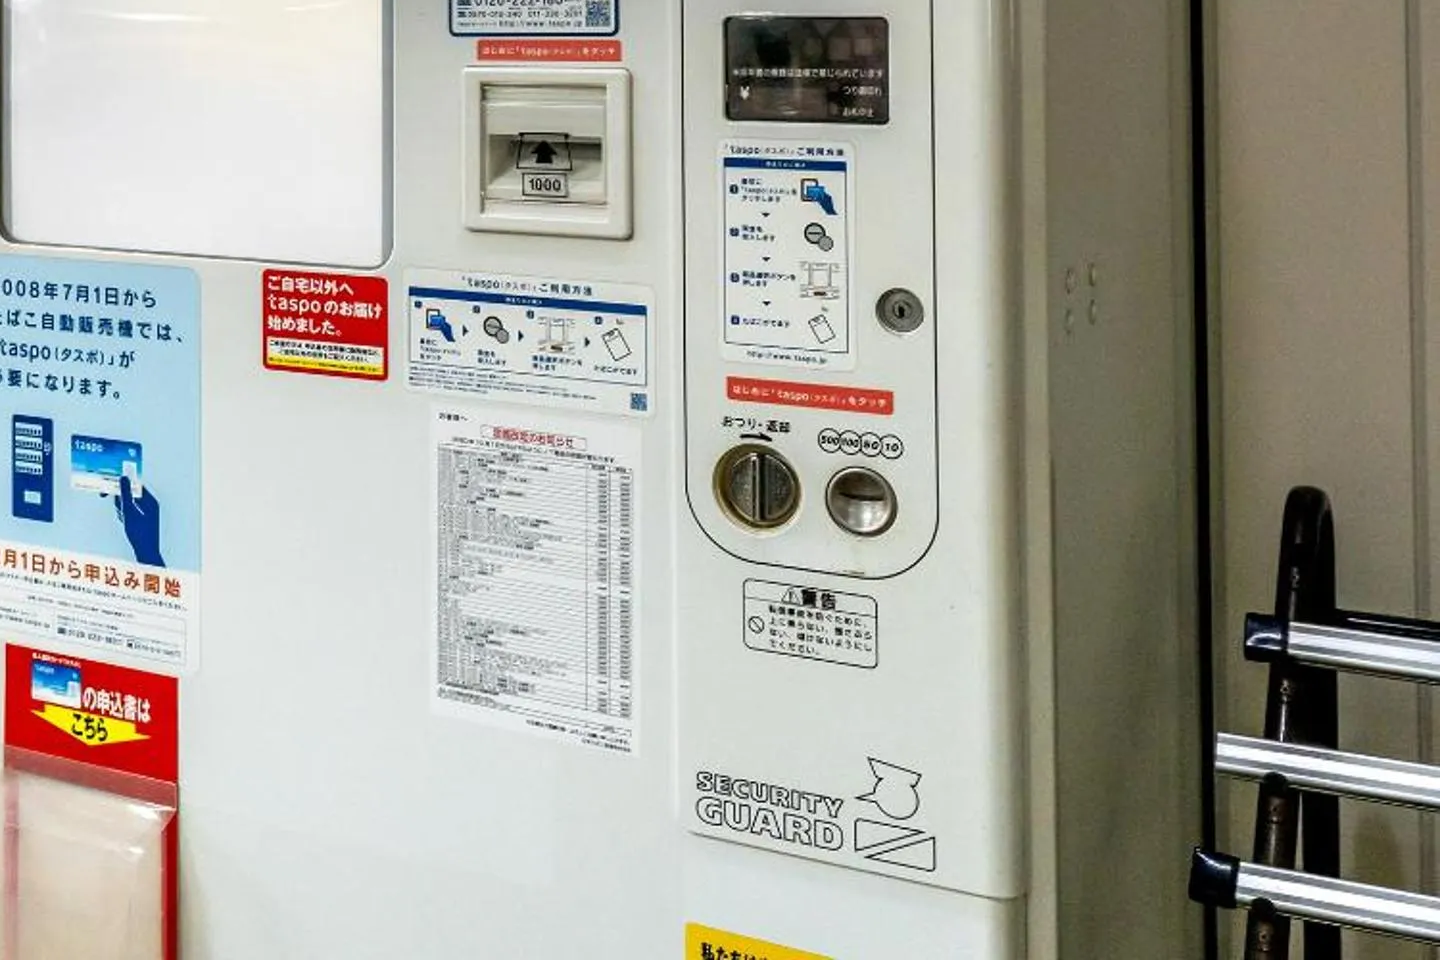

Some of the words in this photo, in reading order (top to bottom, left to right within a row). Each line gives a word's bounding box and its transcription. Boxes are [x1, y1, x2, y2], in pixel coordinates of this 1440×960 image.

[529, 178, 561, 191] 1000
[268, 276, 354, 296] ご自宅以外へ
[268, 315, 342, 336] 始めました。
[820, 435, 839, 446] 500
[842, 437, 859, 448] 100
[885, 441, 898, 452] 10
[83, 686, 151, 723] の申込書は
[71, 713, 108, 742] こちら
[697, 771, 844, 818] SECURITY
[695, 796, 844, 851] GUARD
